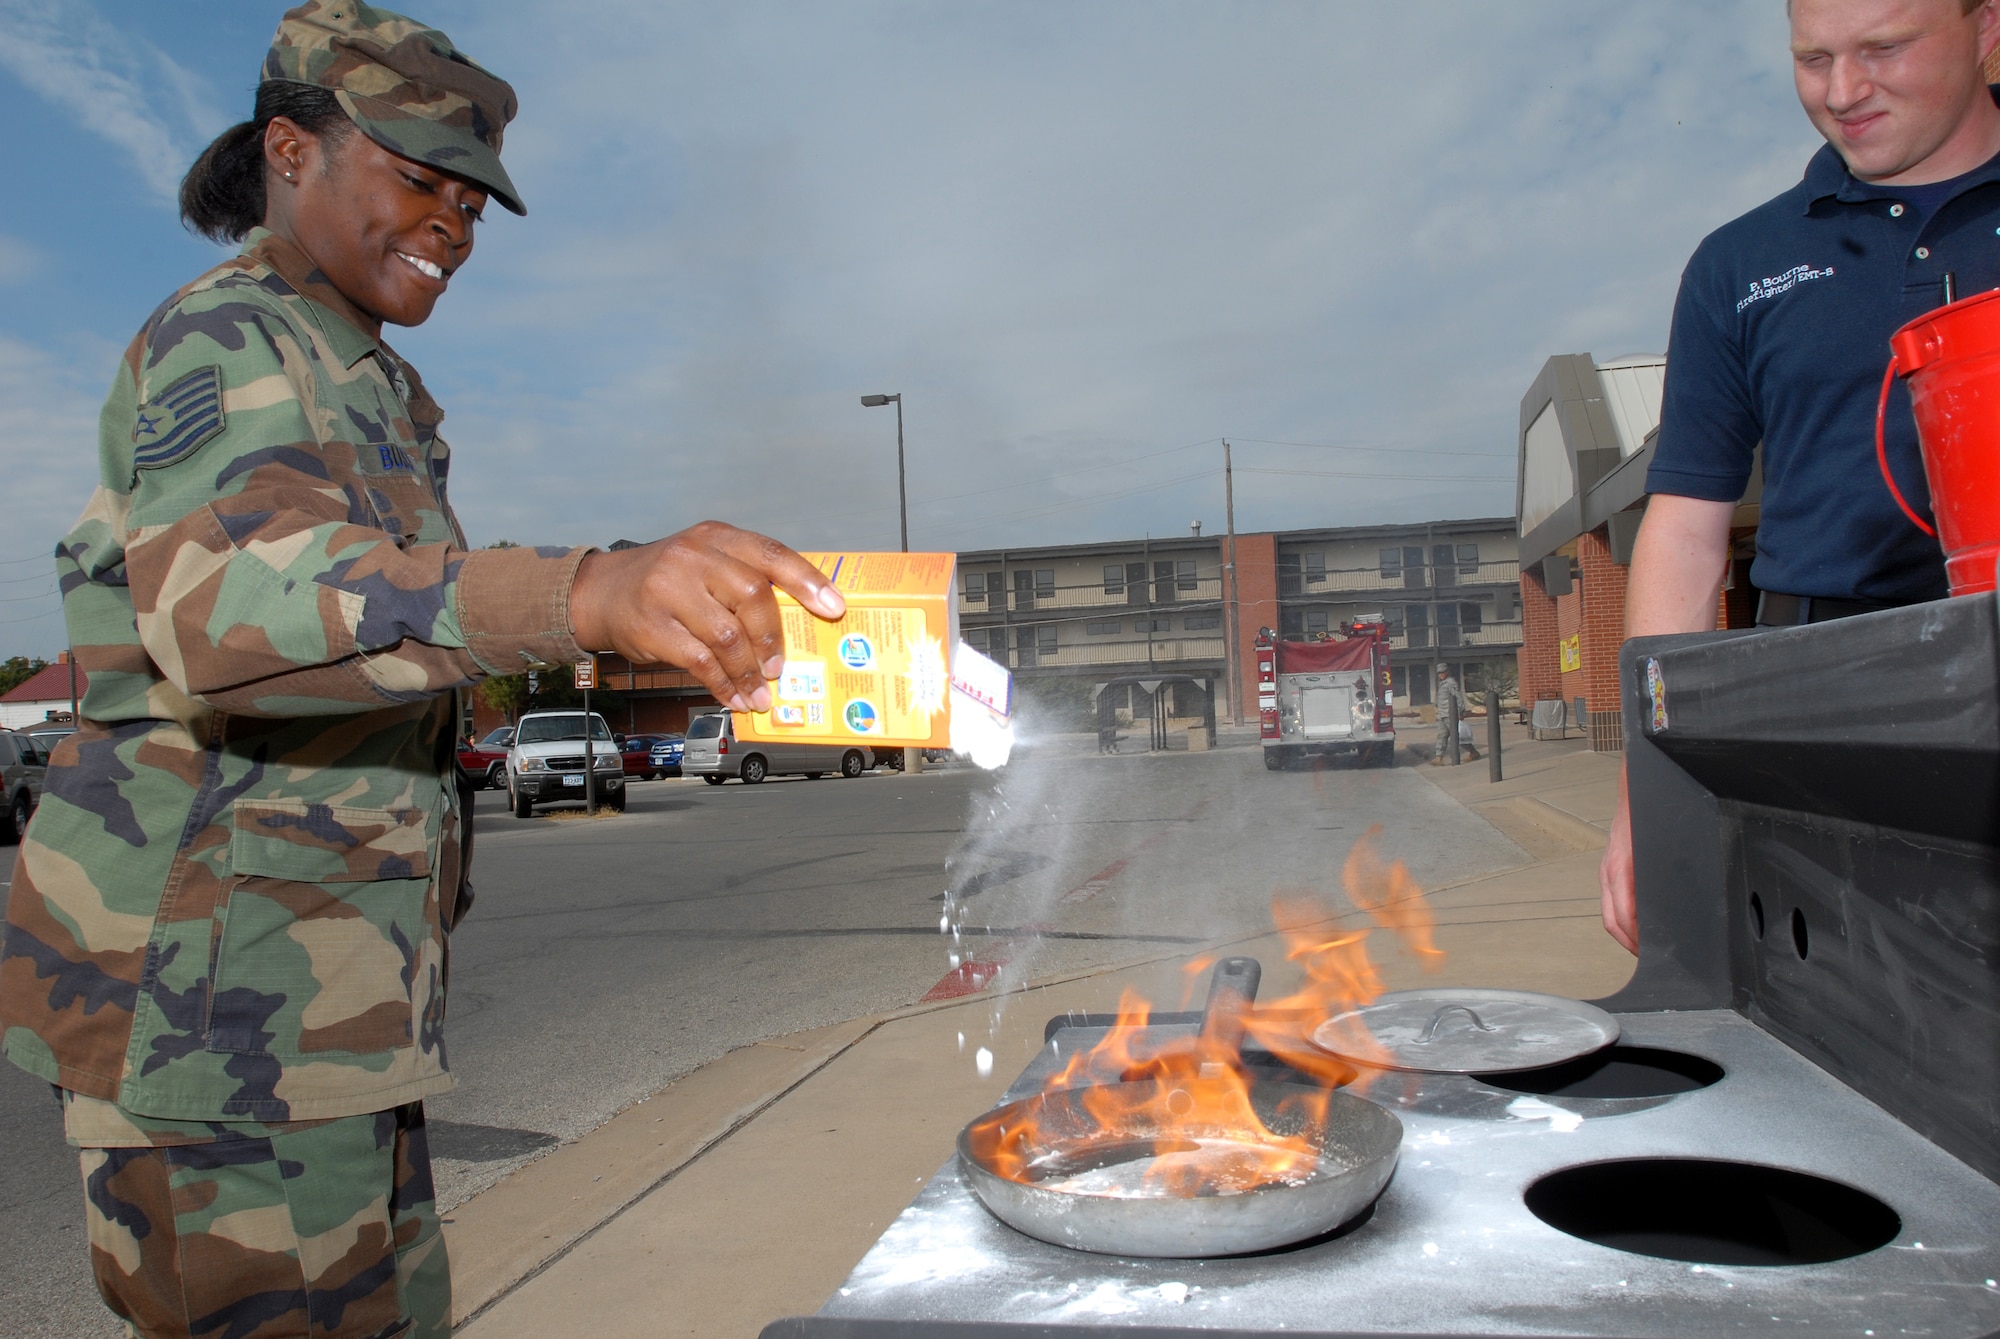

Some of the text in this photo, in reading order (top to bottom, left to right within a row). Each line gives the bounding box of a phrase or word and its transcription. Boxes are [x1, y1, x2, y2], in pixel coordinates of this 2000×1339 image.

[1736, 267, 1834, 312] Firefighter/EMT-B
[1749, 264, 1810, 292] P. Bourne
[1381, 671, 1392, 686] 3
